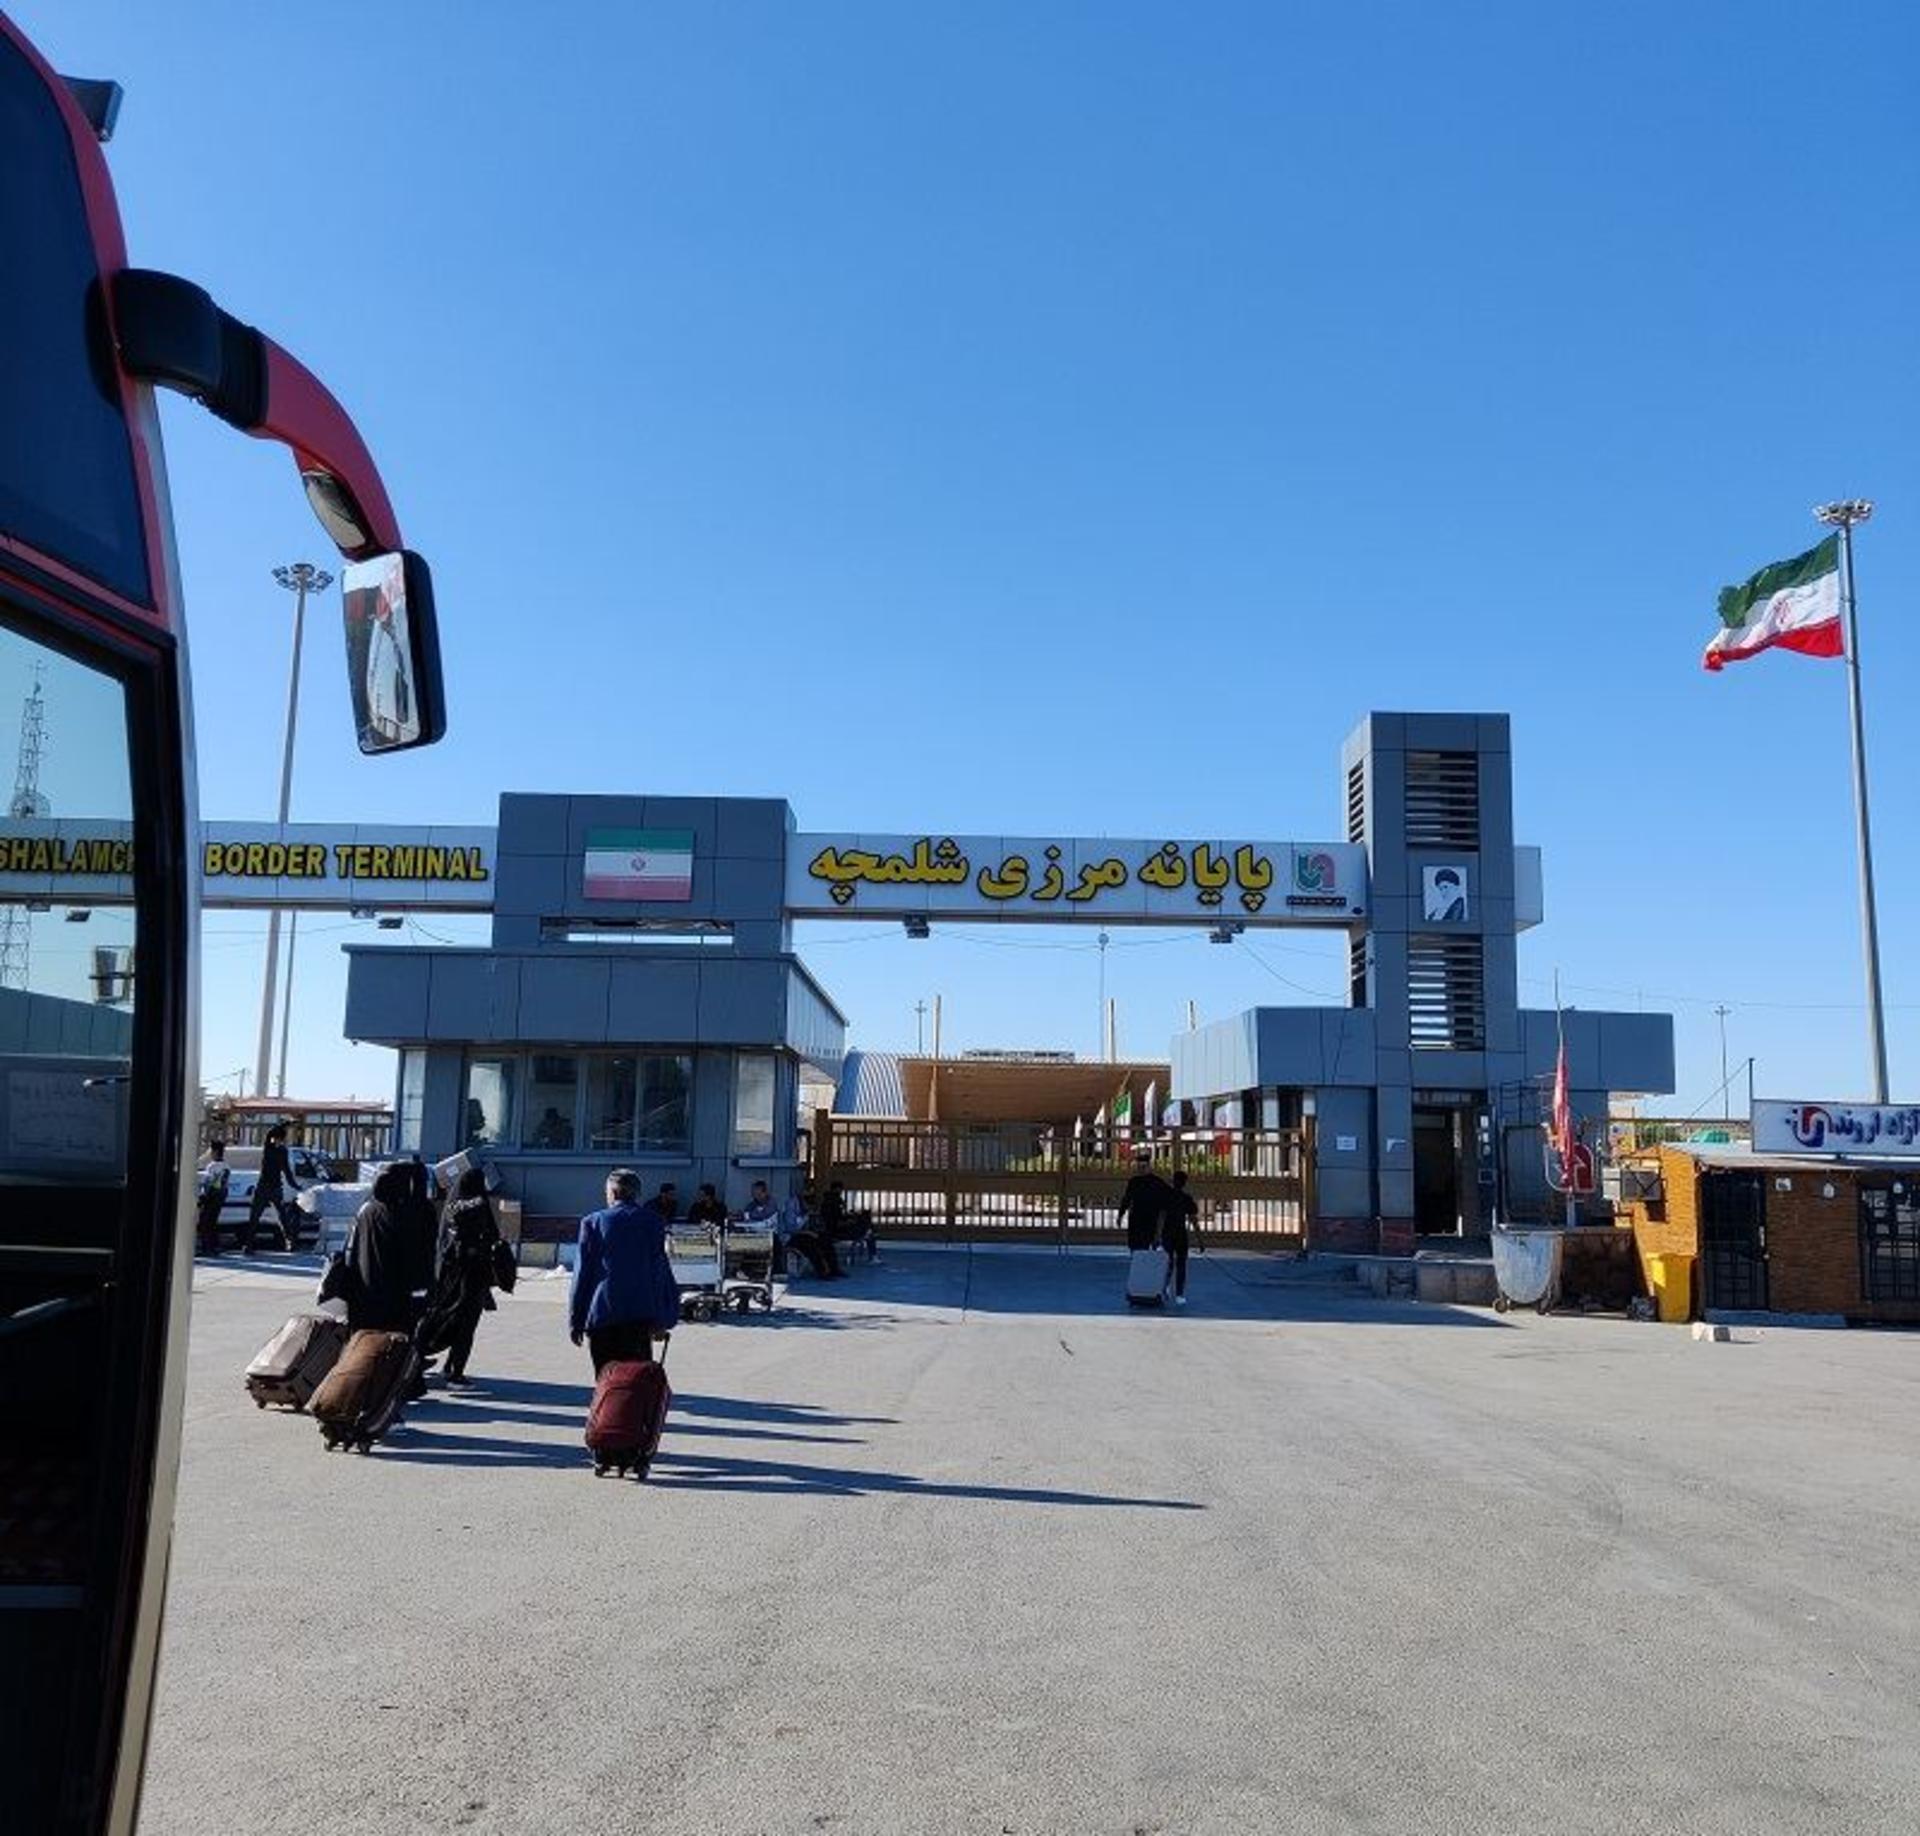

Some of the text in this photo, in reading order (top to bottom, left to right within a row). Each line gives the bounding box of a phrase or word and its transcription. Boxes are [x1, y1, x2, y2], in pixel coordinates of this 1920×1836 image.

[203, 842, 327, 879] BORDER
[336, 845, 488, 881] TERMINAL
[808, 837, 1273, 912] پایانه مرزی شلمچه
